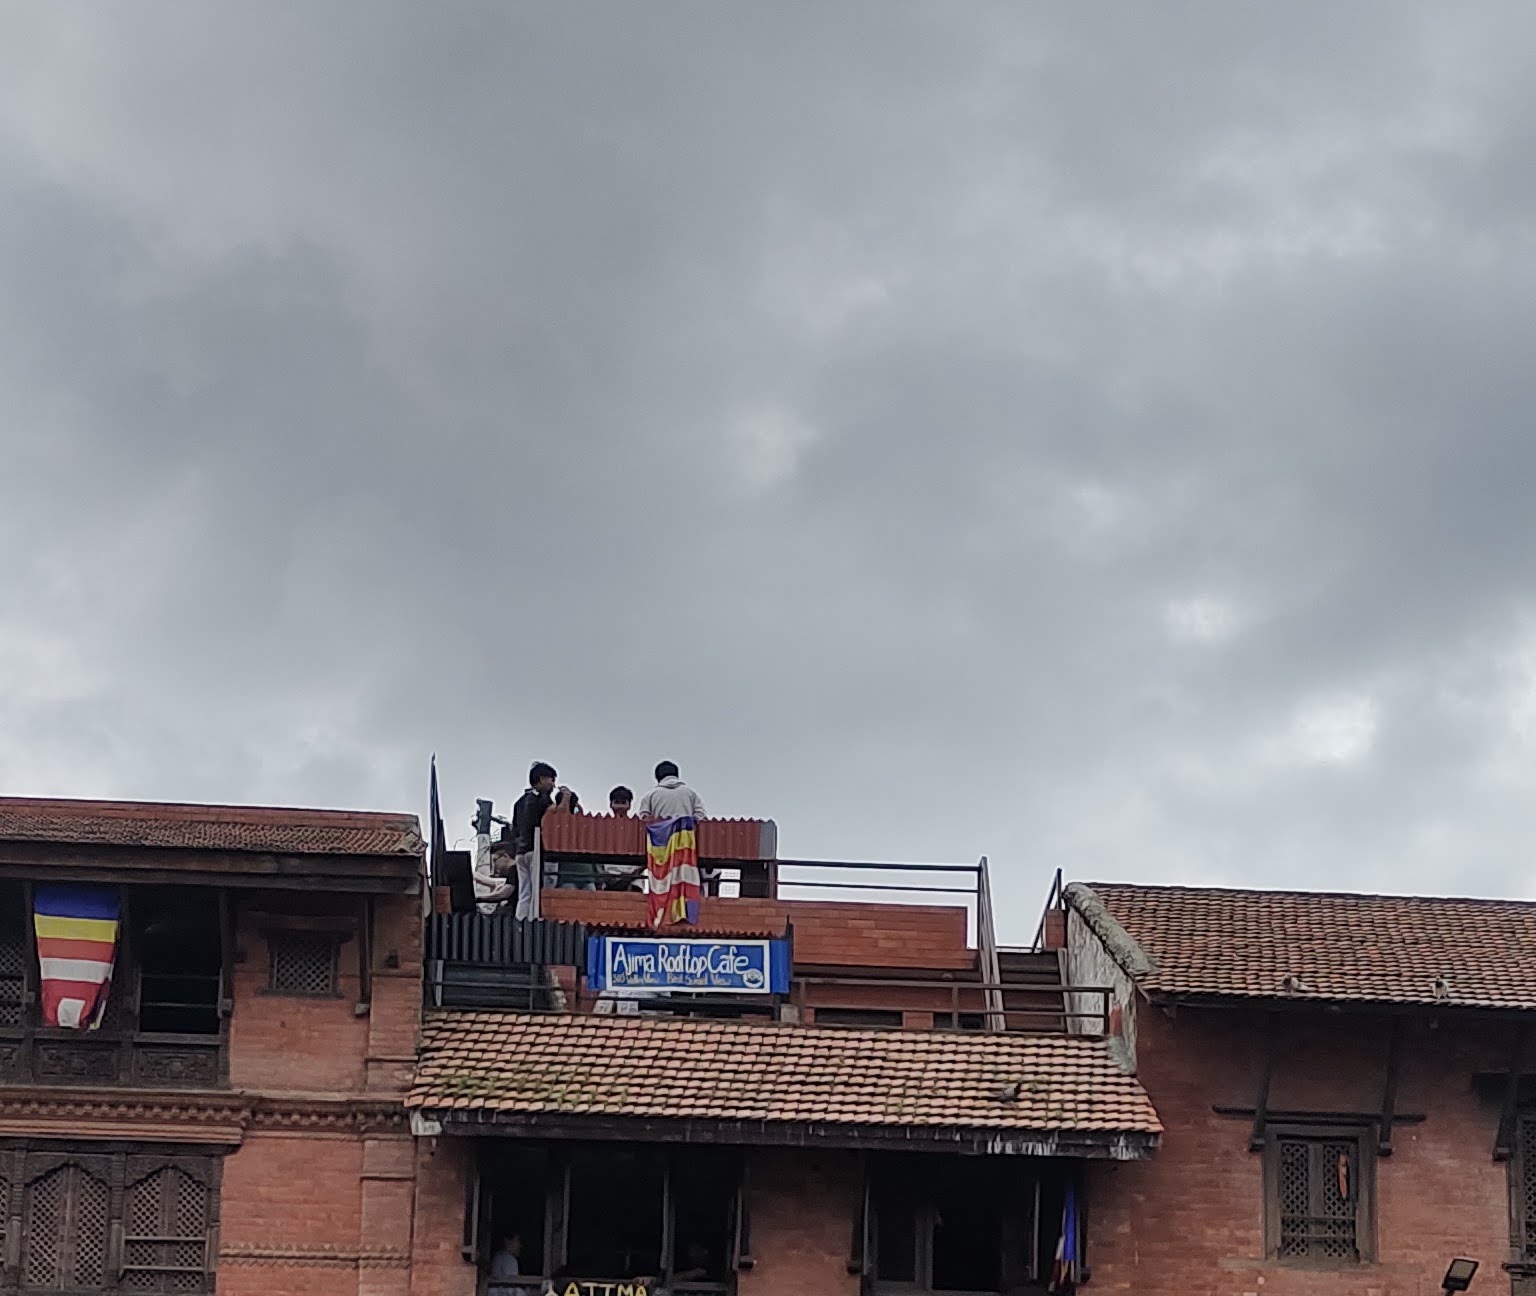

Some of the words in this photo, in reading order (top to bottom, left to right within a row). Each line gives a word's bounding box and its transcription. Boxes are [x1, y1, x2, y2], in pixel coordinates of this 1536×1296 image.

[614, 943, 655, 975] Ajima
[658, 944, 708, 977] Rooftop
[707, 945, 750, 974] Cafe
